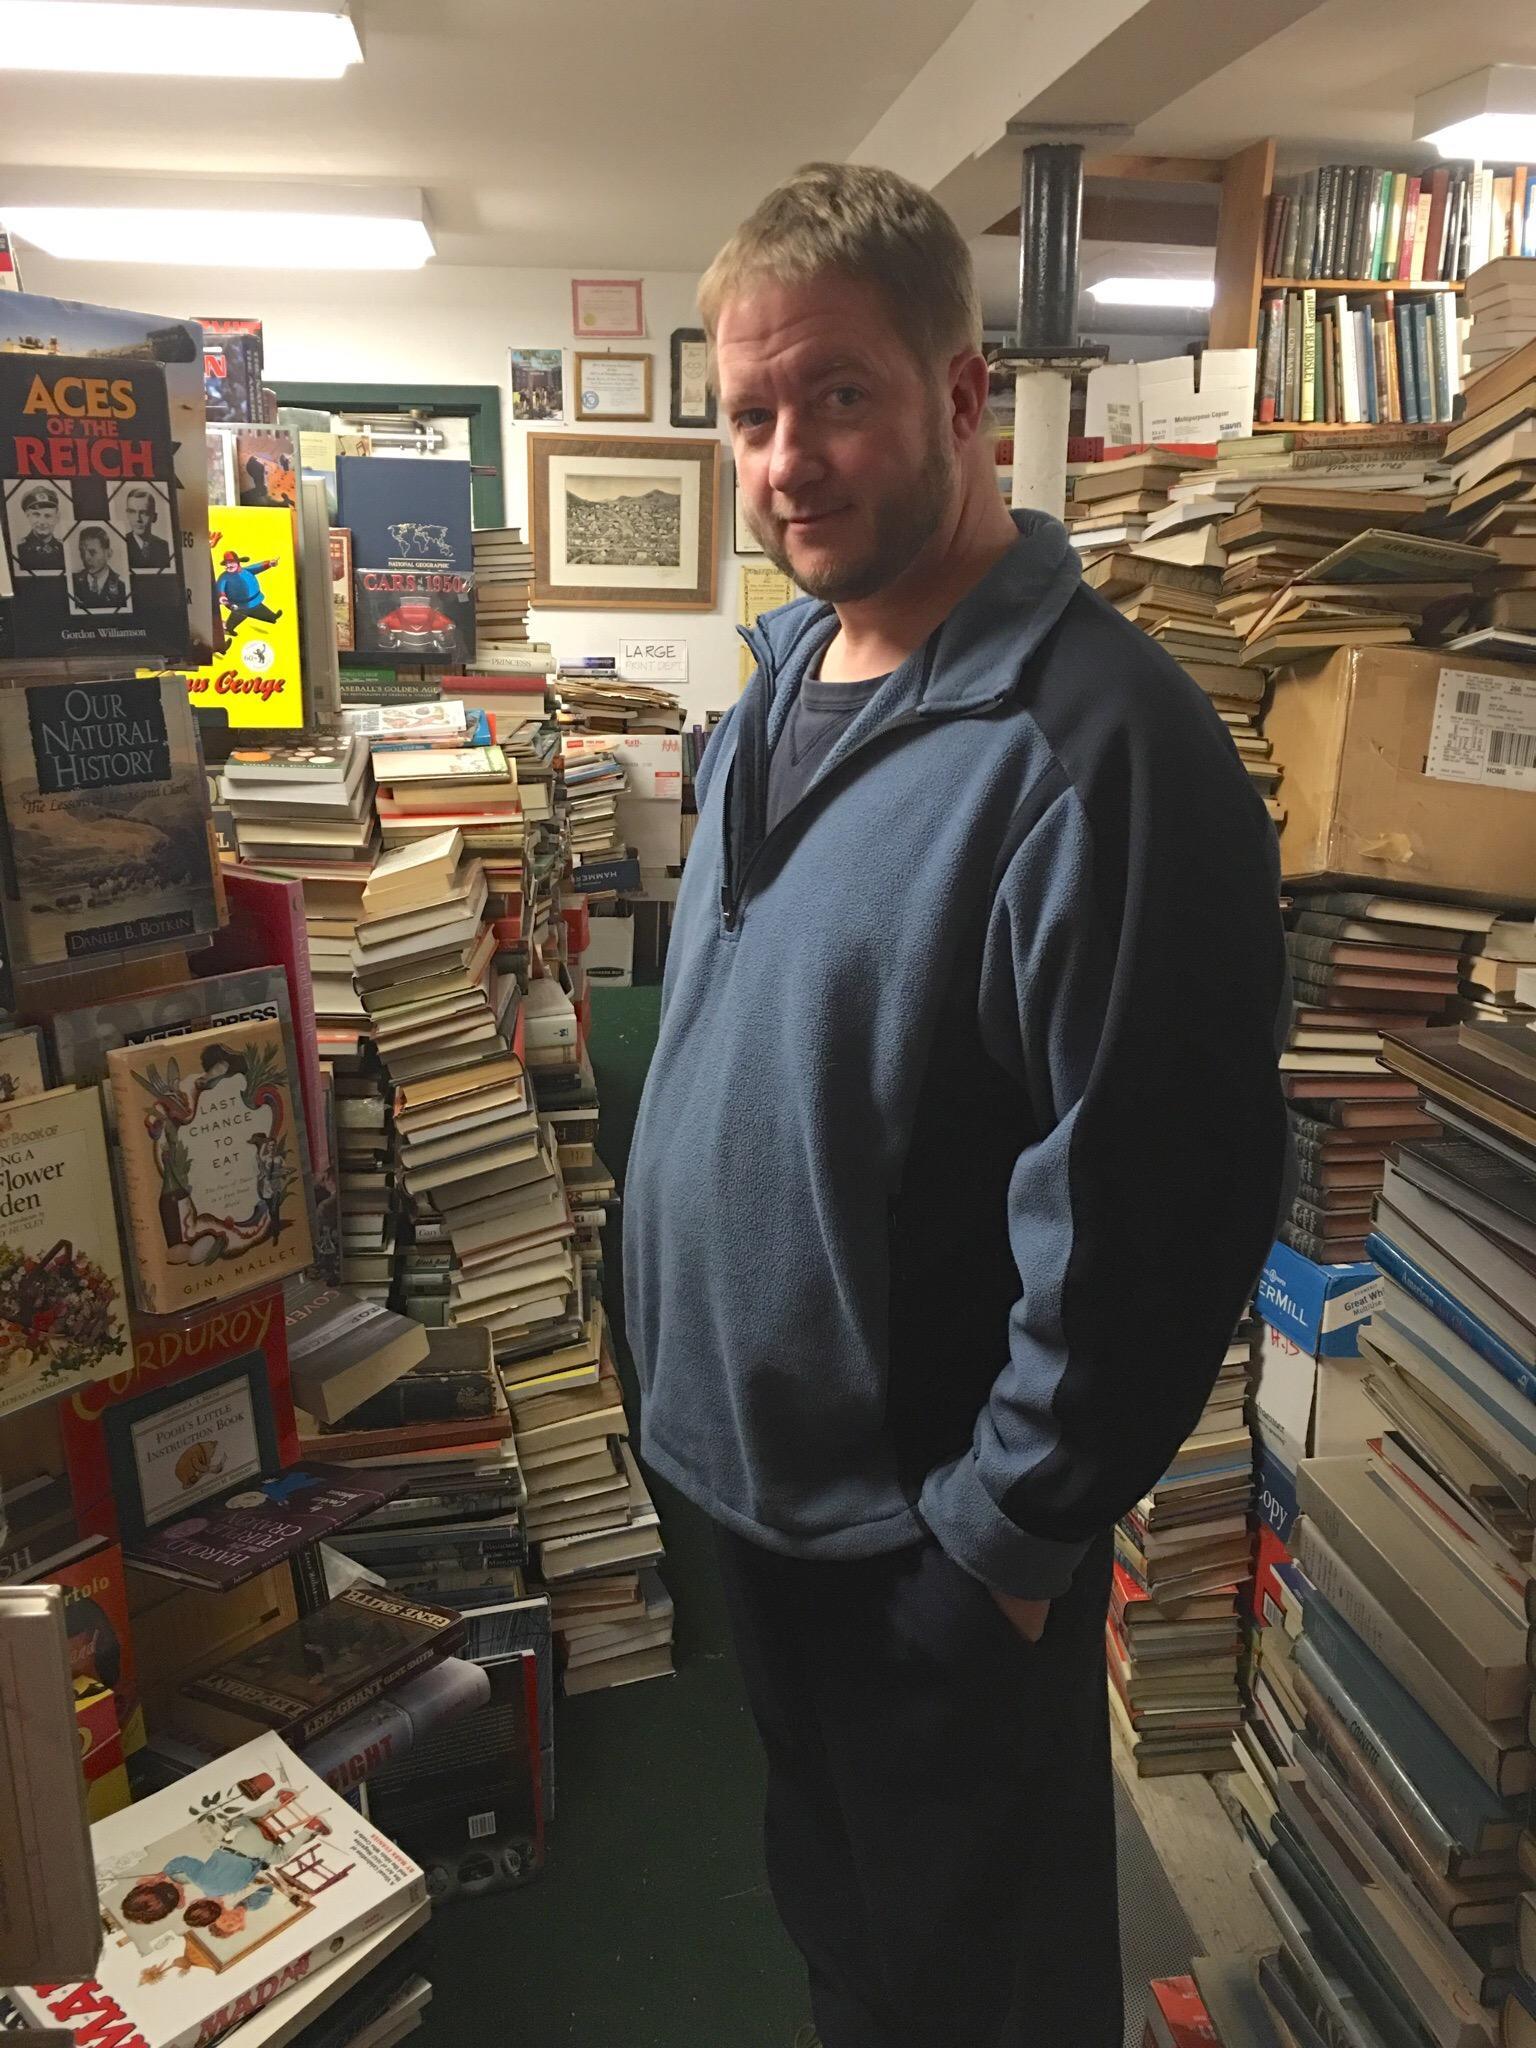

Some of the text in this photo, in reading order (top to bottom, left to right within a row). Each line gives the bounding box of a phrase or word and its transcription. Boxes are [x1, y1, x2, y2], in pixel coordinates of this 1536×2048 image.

[1286, 328, 1297, 354] LEON
[1304, 333, 1316, 384] BEARDSLEY
[22, 373, 138, 419] ACES
[47, 418, 119, 437] OF THE
[1211, 410, 1229, 418] Copier
[1219, 421, 1242, 431] savin
[13, 435, 155, 478] REICH
[363, 573, 417, 592] CARS
[425, 575, 471, 593] 1950
[61, 627, 147, 640] Gordon Williamson
[491, 657, 532, 668] PRINCESS
[625, 645, 676, 659] LARGE
[214, 669, 286, 701] George
[339, 685, 382, 693] ASEBALL'S
[64, 689, 127, 722] OUR
[42, 719, 159, 755] NATURAL
[53, 749, 155, 789] HISTORY
[71, 917, 192, 951] DANIEL B. BOTKIN
[200, 1096, 237, 1115] LAST
[189, 1111, 252, 1137] CHANCE
[214, 1136, 232, 1149] TO
[0, 1149, 34, 1167] NG A
[212, 1152, 240, 1169] EAT
[0, 1193, 41, 1218] den
[184, 1246, 296, 1295] GINA MALLET
[1258, 1279, 1310, 1328] ERMILL
[1344, 1296, 1367, 1311] Great
[70, 1300, 272, 1421] CORDUROY
[146, 1413, 244, 1463] INSTRUCTION BOOK
[156, 1421, 193, 1443] POOH'S
[196, 1405, 232, 1426] LITTLE
[1259, 1472, 1288, 1530] opy
[205, 1528, 285, 1549] PURPLE
[228, 1513, 302, 1538] CRAYON
[167, 1540, 251, 1567] HAROLD
[64, 1575, 110, 1607] rtolo
[341, 1590, 449, 1628] GENE SMITH
[383, 1648, 435, 1686] GENE SMITH
[1347, 1719, 1381, 1766] CORVETTE
[389, 1851, 406, 1866] MARK
[31, 1980, 150, 2048] MA
[196, 1976, 279, 2044] MAD
